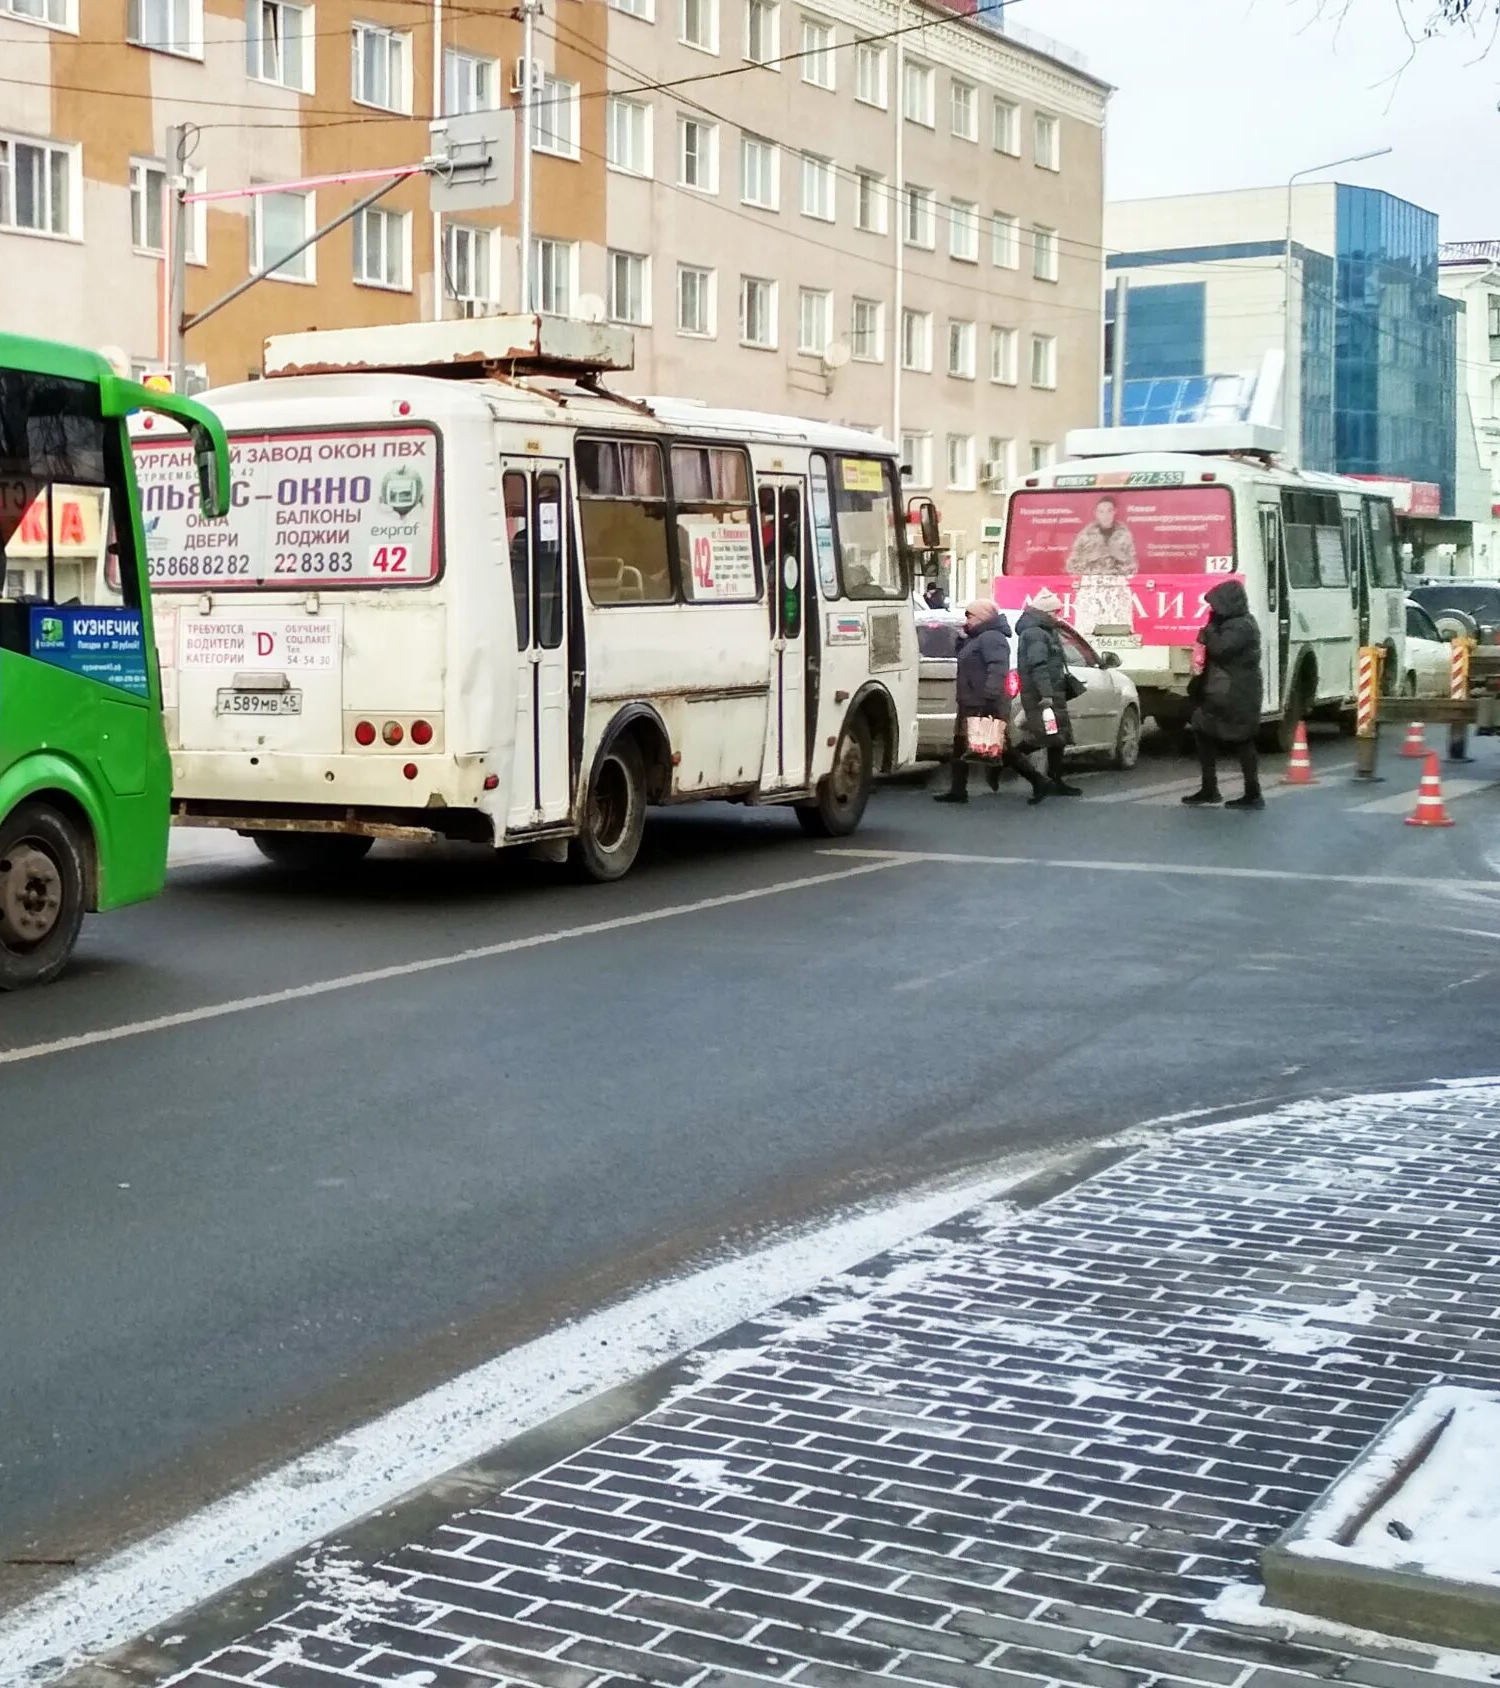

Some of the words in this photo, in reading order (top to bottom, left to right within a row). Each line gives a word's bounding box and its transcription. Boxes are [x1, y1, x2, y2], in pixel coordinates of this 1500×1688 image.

[246, 445, 313, 464] ЗАВОД
[318, 442, 376, 460] ОКОН
[382, 441, 427, 458] ПВХ
[1129, 472, 1182, 486] 227-533
[186, 513, 230, 528] ОКНА
[276, 508, 362, 525] БАЛКОНЫ
[275, 529, 350, 546] ЛОДЖИИ
[370, 522, 420, 539] exprof
[184, 532, 239, 550] ДВЕРИ
[372, 546, 408, 573] 42
[1210, 557, 1229, 571] 12
[73, 619, 140, 636] КУЗНЕЧИК
[187, 624, 244, 635] ТРЕБУЮТСЯ
[285, 624, 331, 634] ОБУЧЕНИЕ
[187, 638, 245, 651] ВОДИТЕЛИ
[186, 653, 245, 665] КАТЕГОРИИ
[287, 655, 299, 665] 54
[303, 655, 315, 665] 54
[223, 696, 278, 712] А589МВ
[282, 695, 297, 708] 45
